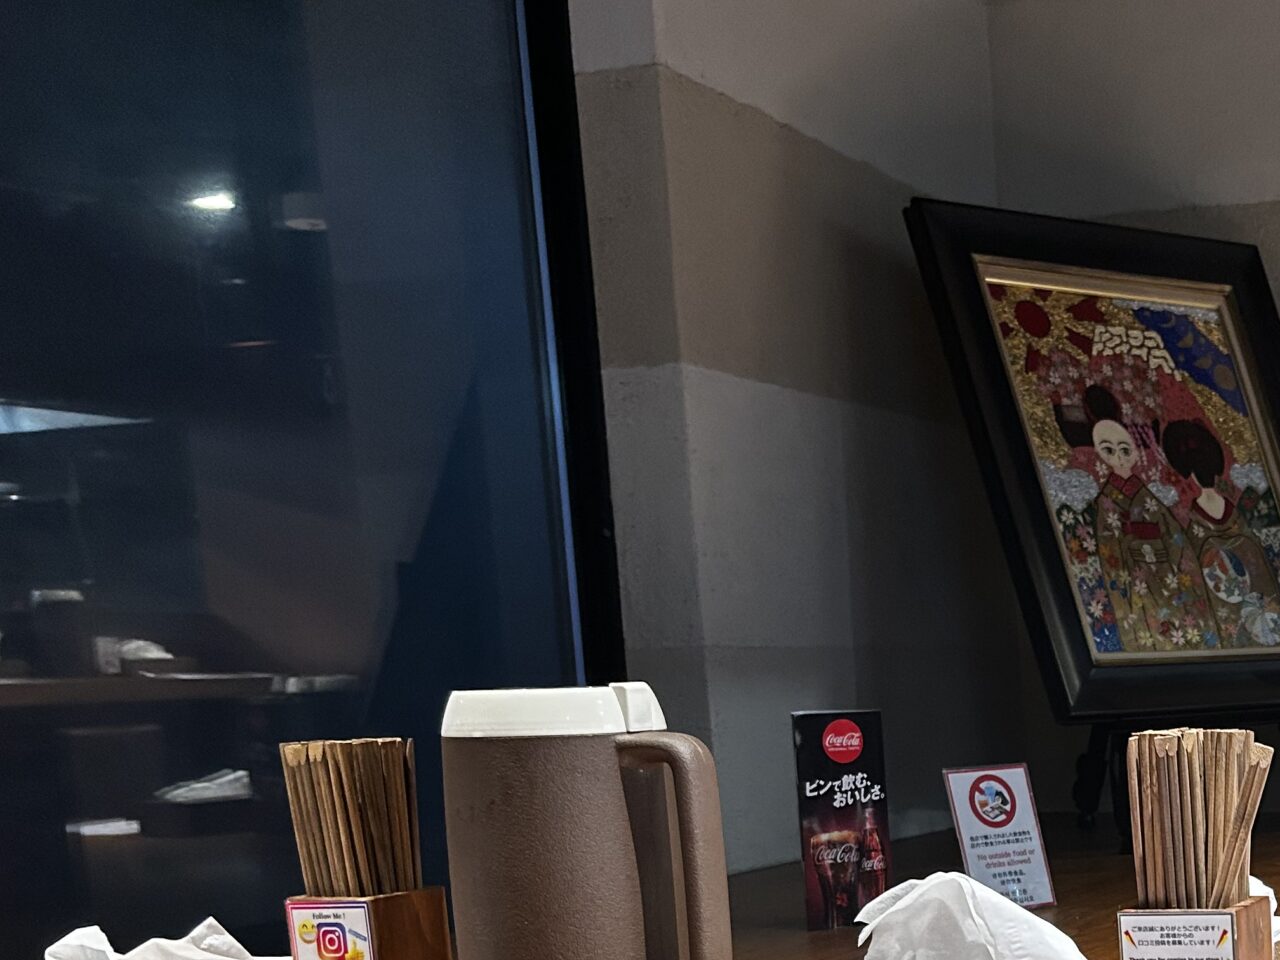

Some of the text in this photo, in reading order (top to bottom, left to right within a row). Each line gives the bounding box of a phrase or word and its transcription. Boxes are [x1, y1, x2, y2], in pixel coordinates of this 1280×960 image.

[806, 772, 871, 797] ビンで飲む、
[833, 784, 885, 808] おいしさ。
[985, 857, 1032, 869] drinks allowed
[988, 851, 1011, 860] outside
[1012, 849, 1027, 857] food
